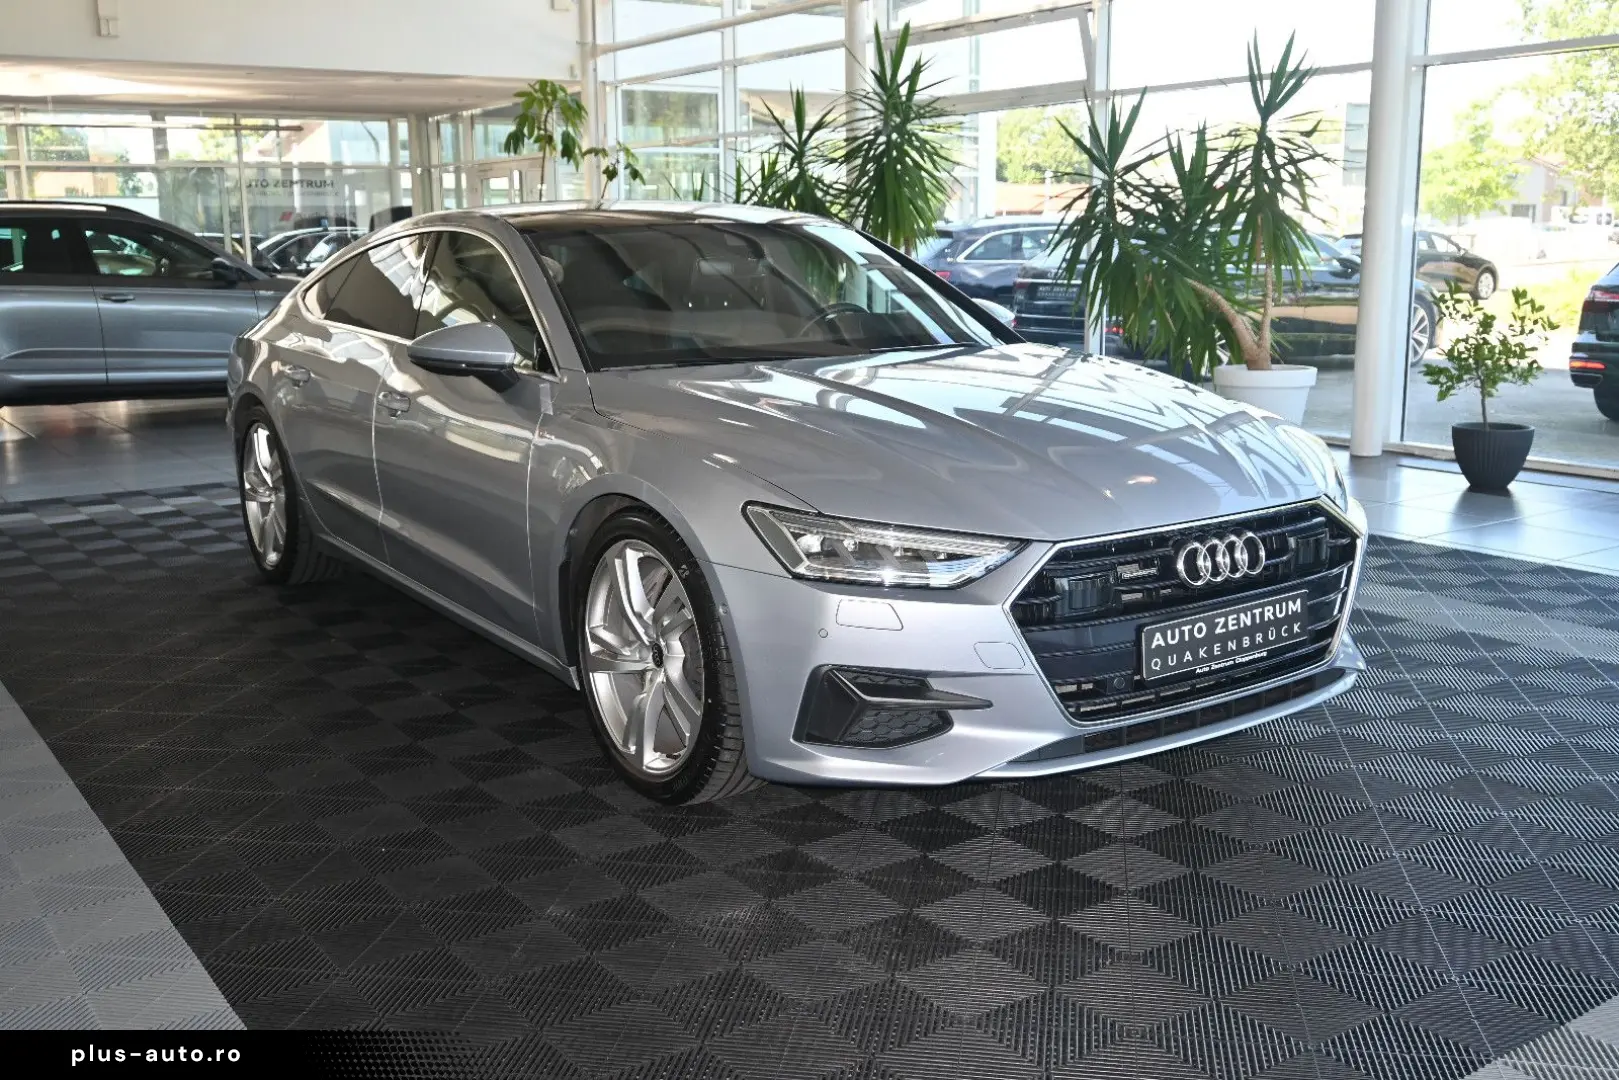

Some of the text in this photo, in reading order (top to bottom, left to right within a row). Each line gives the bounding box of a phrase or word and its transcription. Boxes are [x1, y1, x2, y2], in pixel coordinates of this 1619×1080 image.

[1151, 598, 1301, 649] AUTO ZENTRUM
[1151, 622, 1301, 671] QUAKENBRÜCK
[1195, 666, 1210, 674] Auto
[1211, 660, 1235, 670] Zentrum
